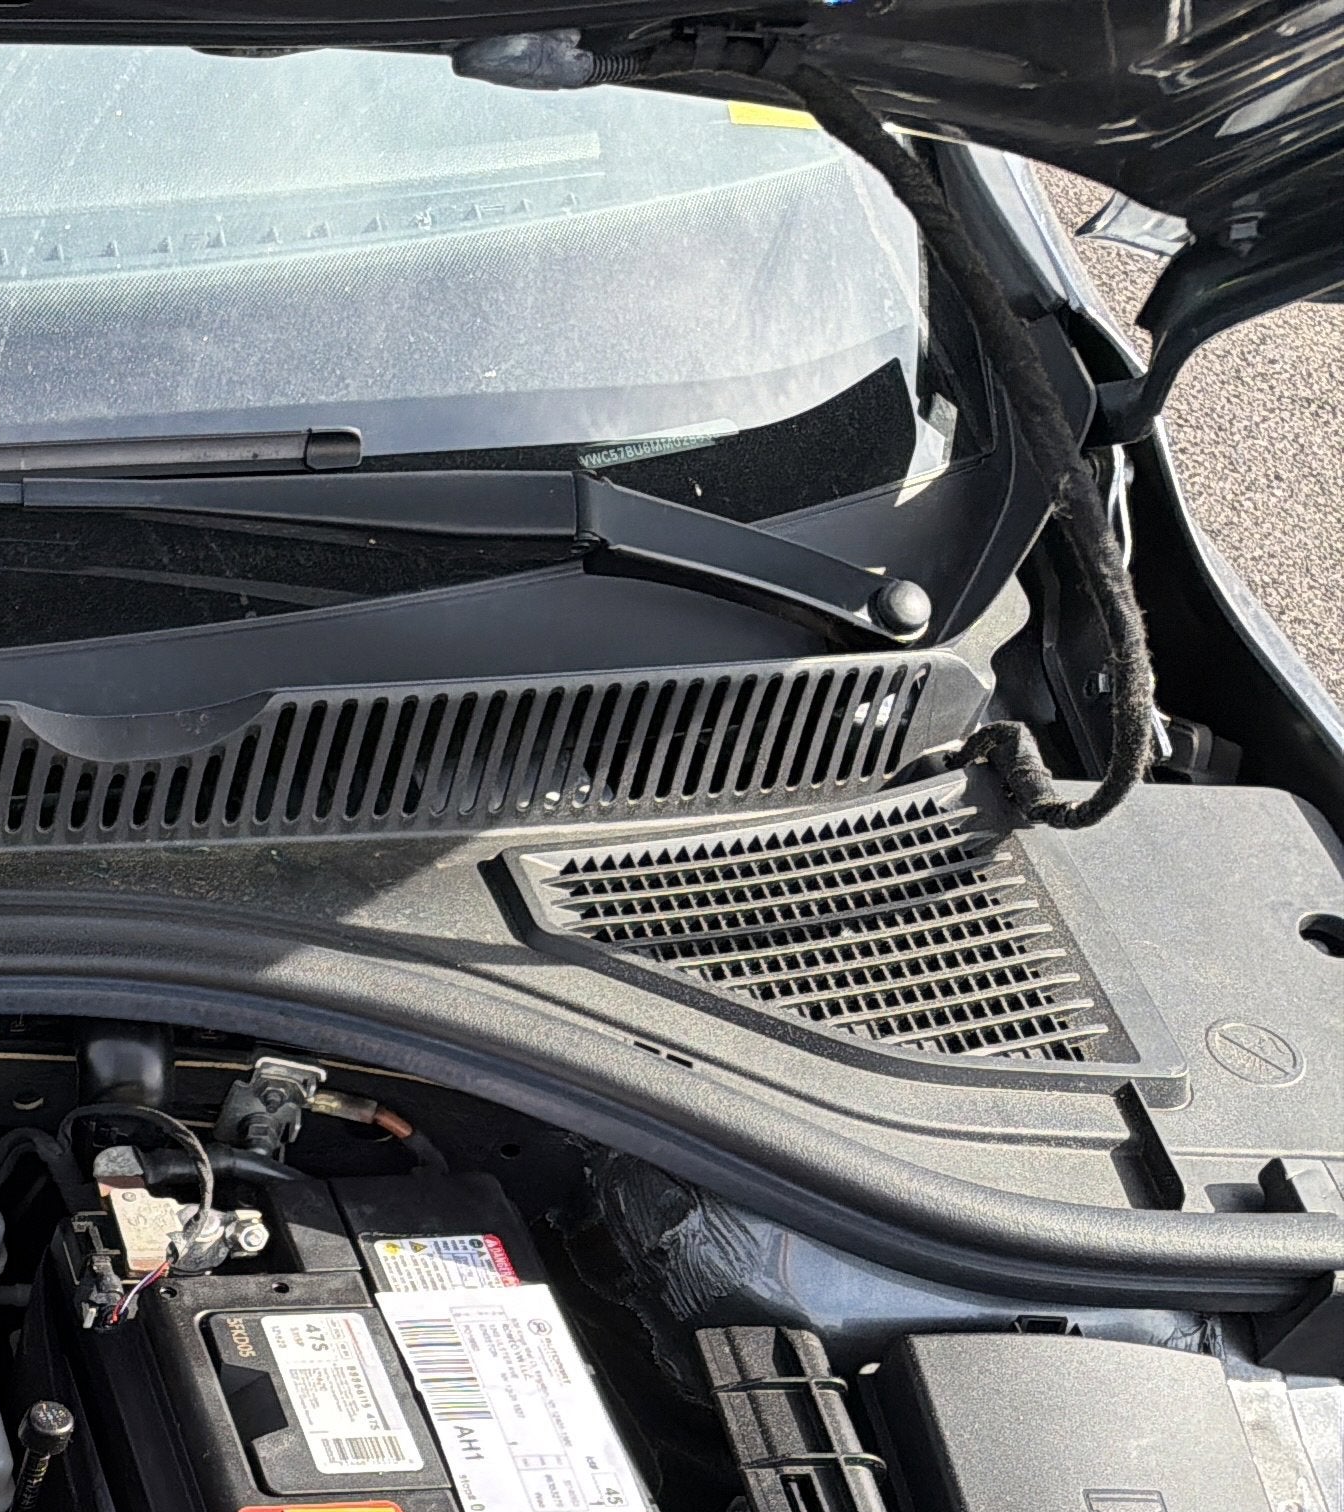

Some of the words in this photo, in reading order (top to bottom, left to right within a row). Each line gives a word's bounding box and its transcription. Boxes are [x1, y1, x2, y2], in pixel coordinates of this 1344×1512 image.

[302, 1323, 330, 1352] 47S
[451, 1424, 486, 1461] AH1
[601, 1486, 624, 1505] 45
